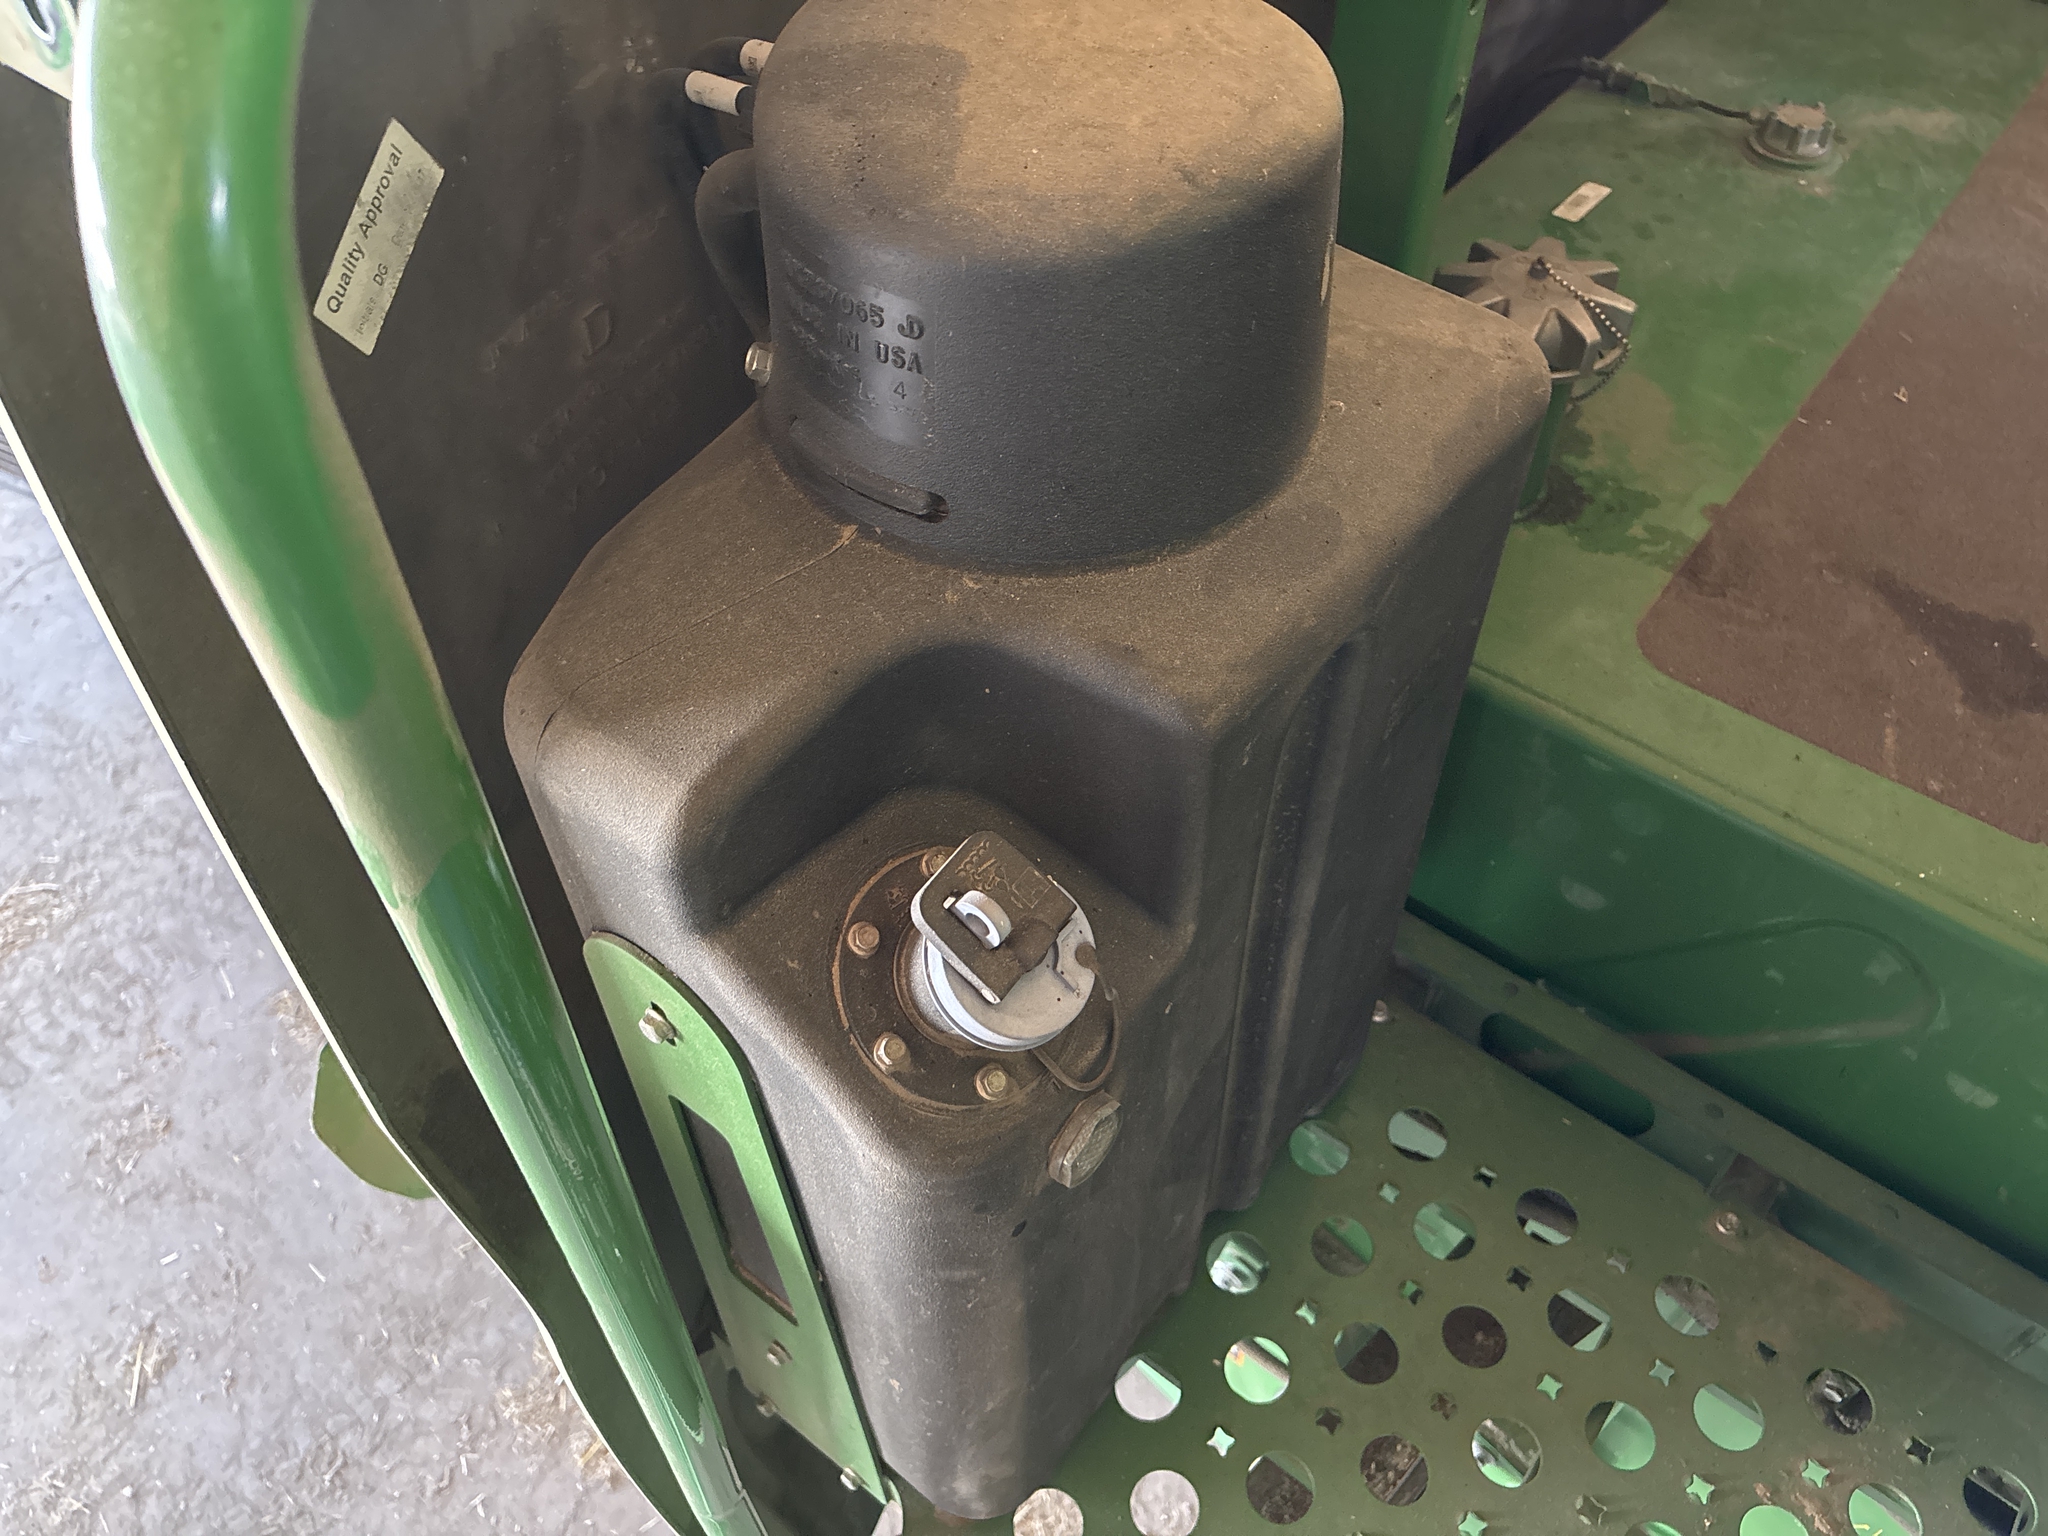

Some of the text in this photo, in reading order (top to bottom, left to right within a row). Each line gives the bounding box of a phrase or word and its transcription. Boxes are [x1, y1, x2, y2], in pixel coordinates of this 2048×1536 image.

[326, 143, 404, 315] Quality Approval
[372, 262, 389, 287] DG
[874, 339, 923, 375] USA
[893, 381, 907, 400] 4
